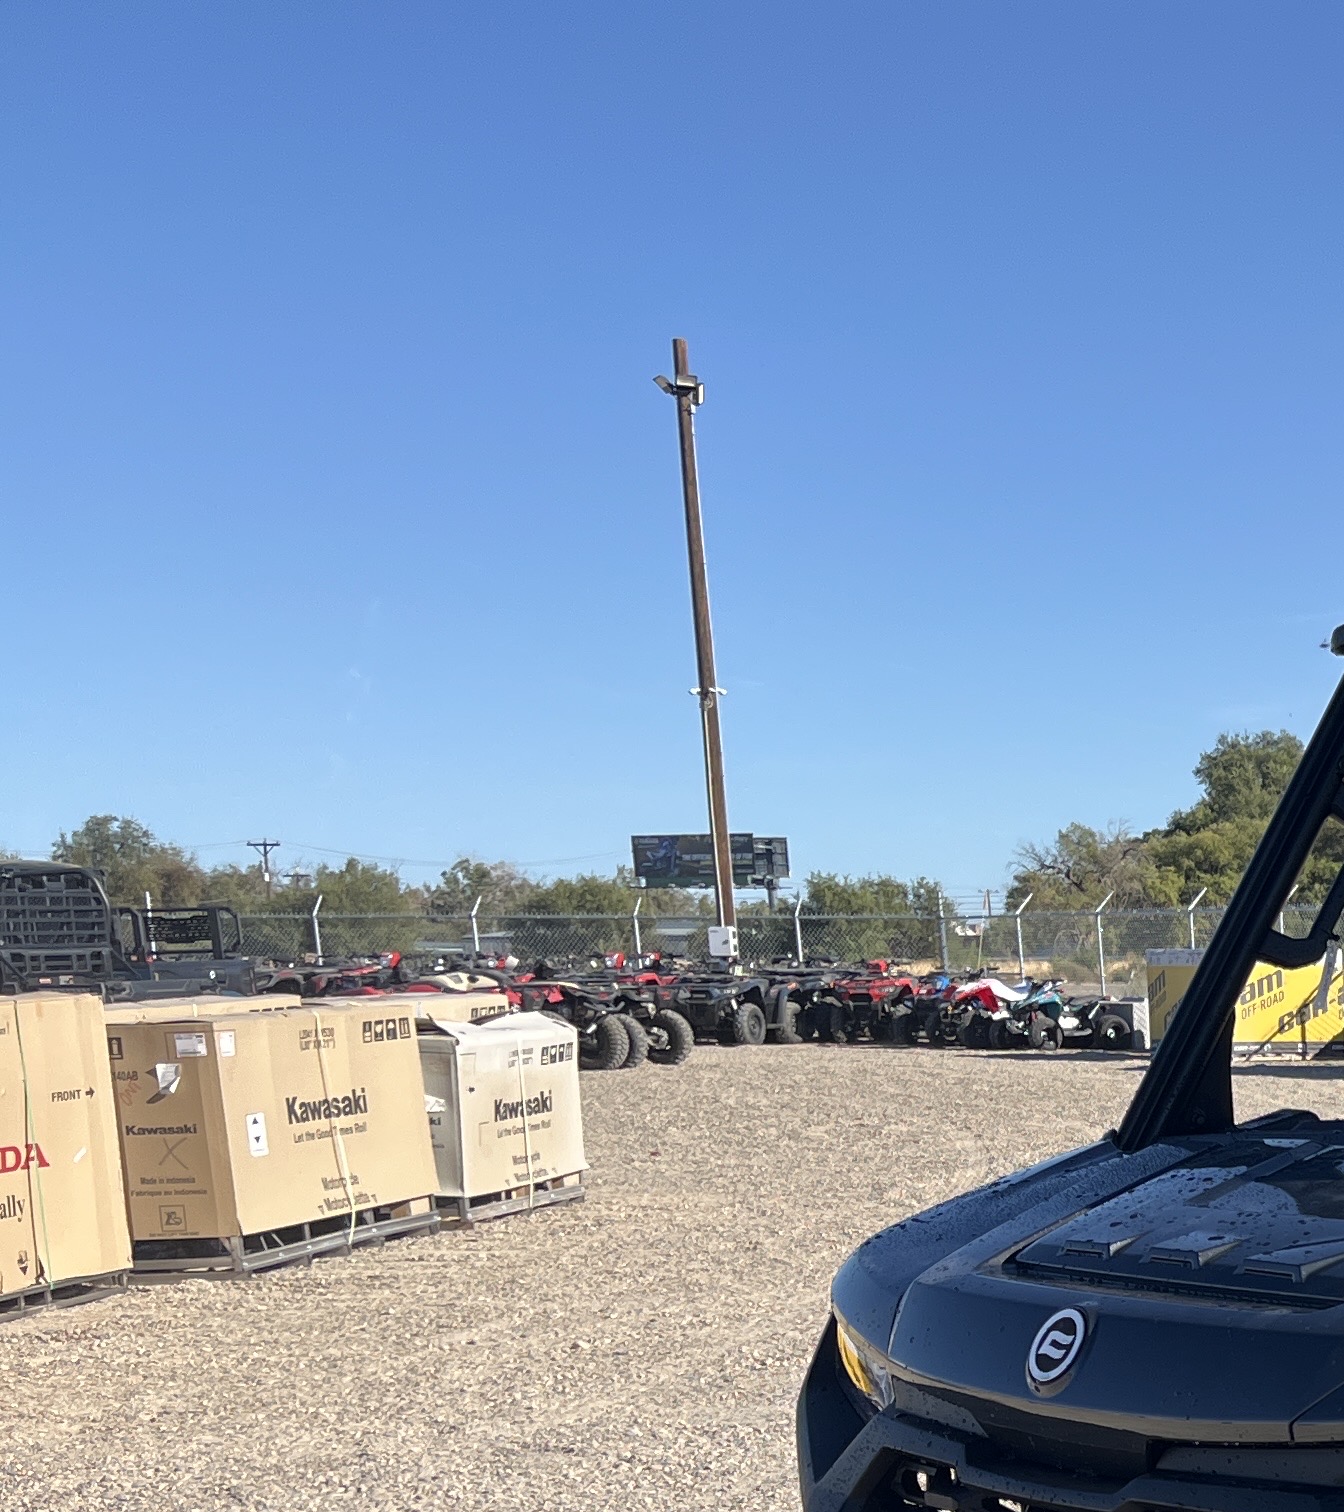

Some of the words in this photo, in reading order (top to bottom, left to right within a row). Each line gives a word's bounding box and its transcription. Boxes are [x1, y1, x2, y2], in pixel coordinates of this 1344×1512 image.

[51, 1089, 82, 1103] FRONT
[286, 1088, 369, 1125] Kawasaki
[494, 1089, 553, 1122] Kawasaki
[125, 1123, 197, 1136] Kawasaki
